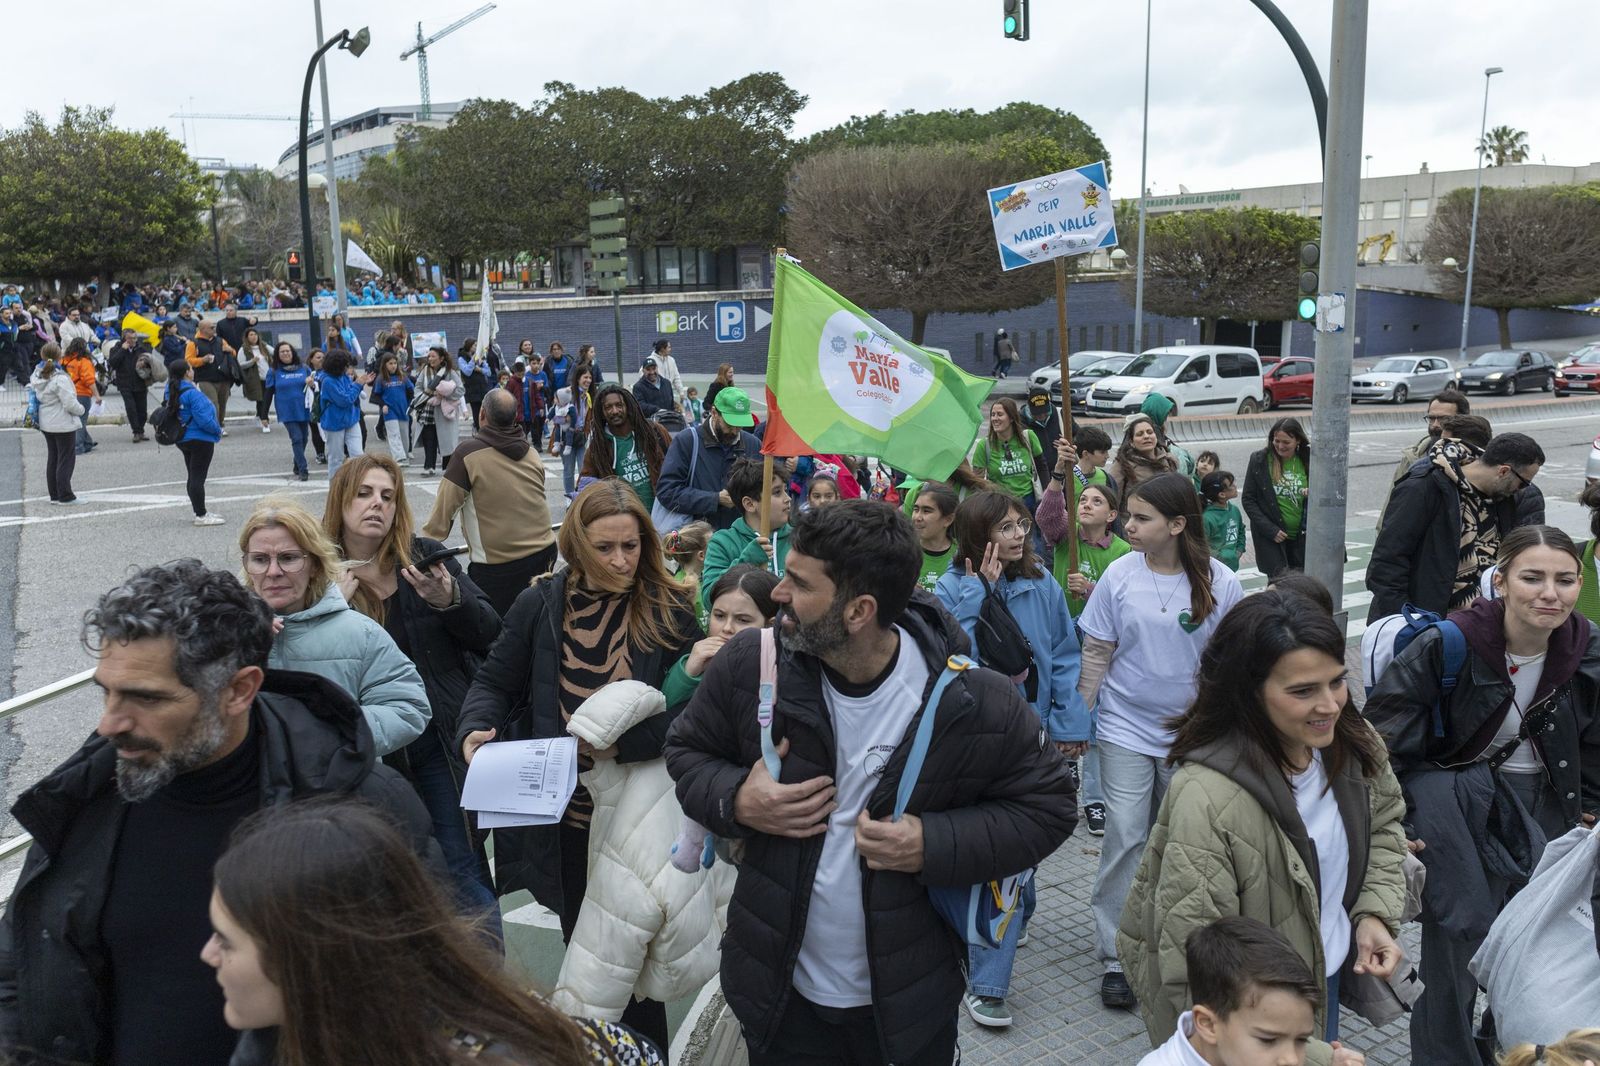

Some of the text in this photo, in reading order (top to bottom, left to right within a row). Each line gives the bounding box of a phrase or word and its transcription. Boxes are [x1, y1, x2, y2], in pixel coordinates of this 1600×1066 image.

[1038, 198, 1059, 214] CEIP
[1014, 211, 1097, 244] MARÍA VALLE
[656, 310, 709, 333] iPark
[854, 345, 899, 369] María
[848, 361, 900, 394] Valle
[622, 467, 650, 483] Vall
[998, 464, 1028, 475] Valle
